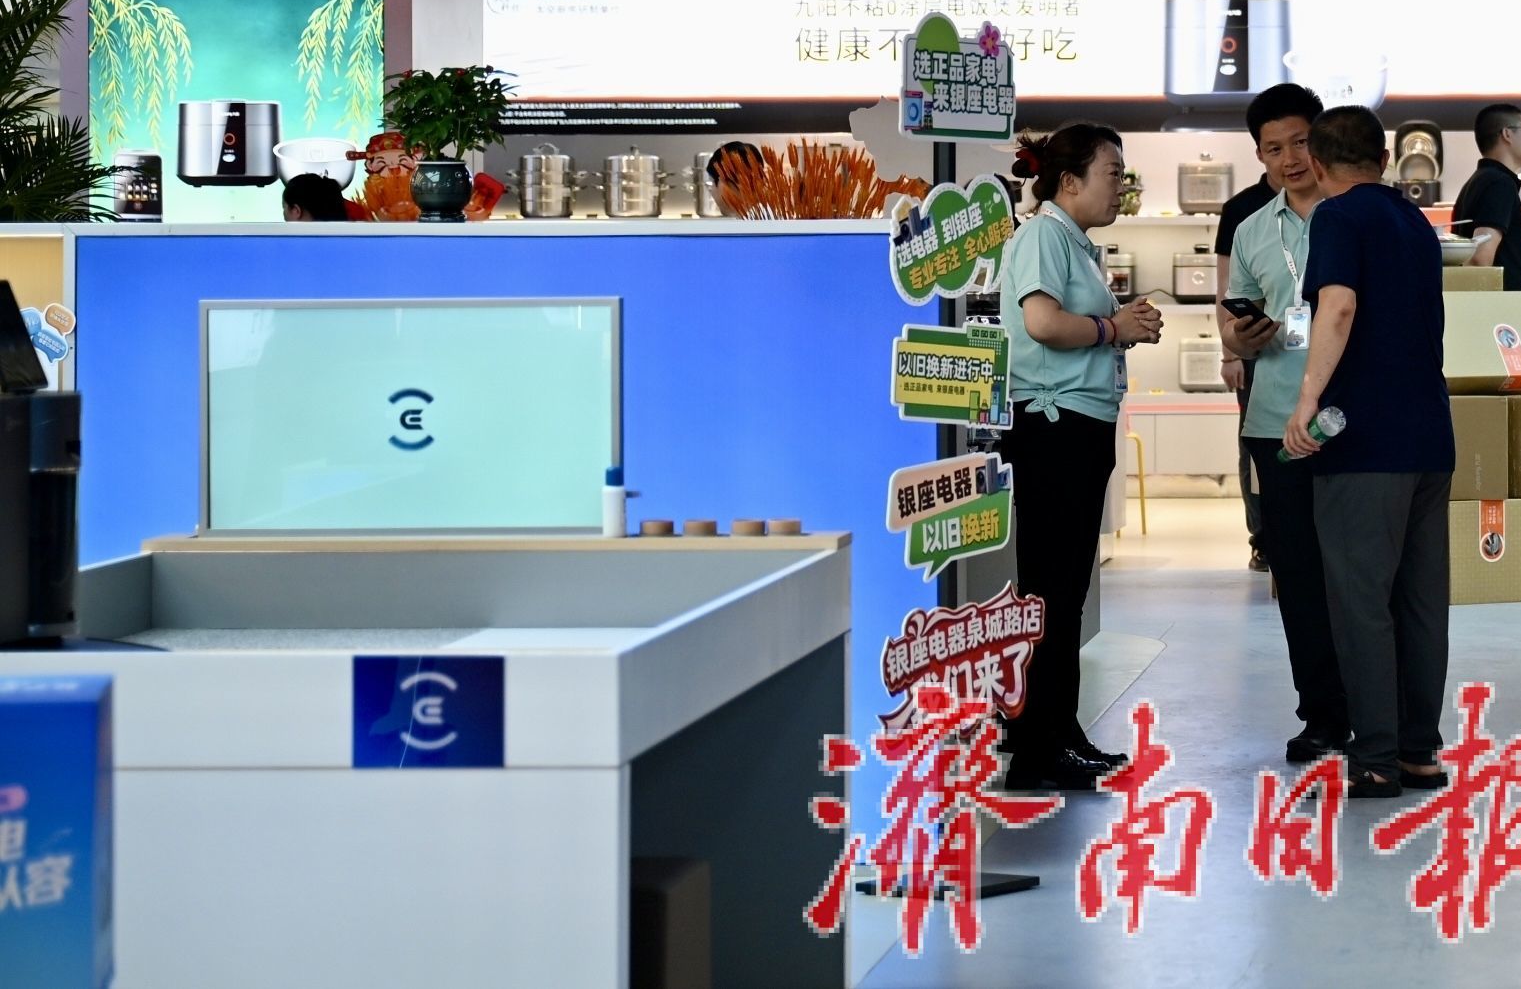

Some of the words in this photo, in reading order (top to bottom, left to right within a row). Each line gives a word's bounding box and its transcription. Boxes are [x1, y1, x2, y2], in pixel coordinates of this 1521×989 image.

[795, 26, 1078, 63] 健康不好吃
[913, 49, 998, 86] 选正品家电
[933, 82, 1014, 116] 来银座电器
[941, 202, 984, 245] 到银座
[909, 246, 961, 289] 专业专注
[964, 216, 1013, 261] 全心服务
[897, 466, 972, 518] 银座电器
[922, 509, 999, 555] 以旧换新
[886, 601, 1042, 685] 银座电器泉城路店
